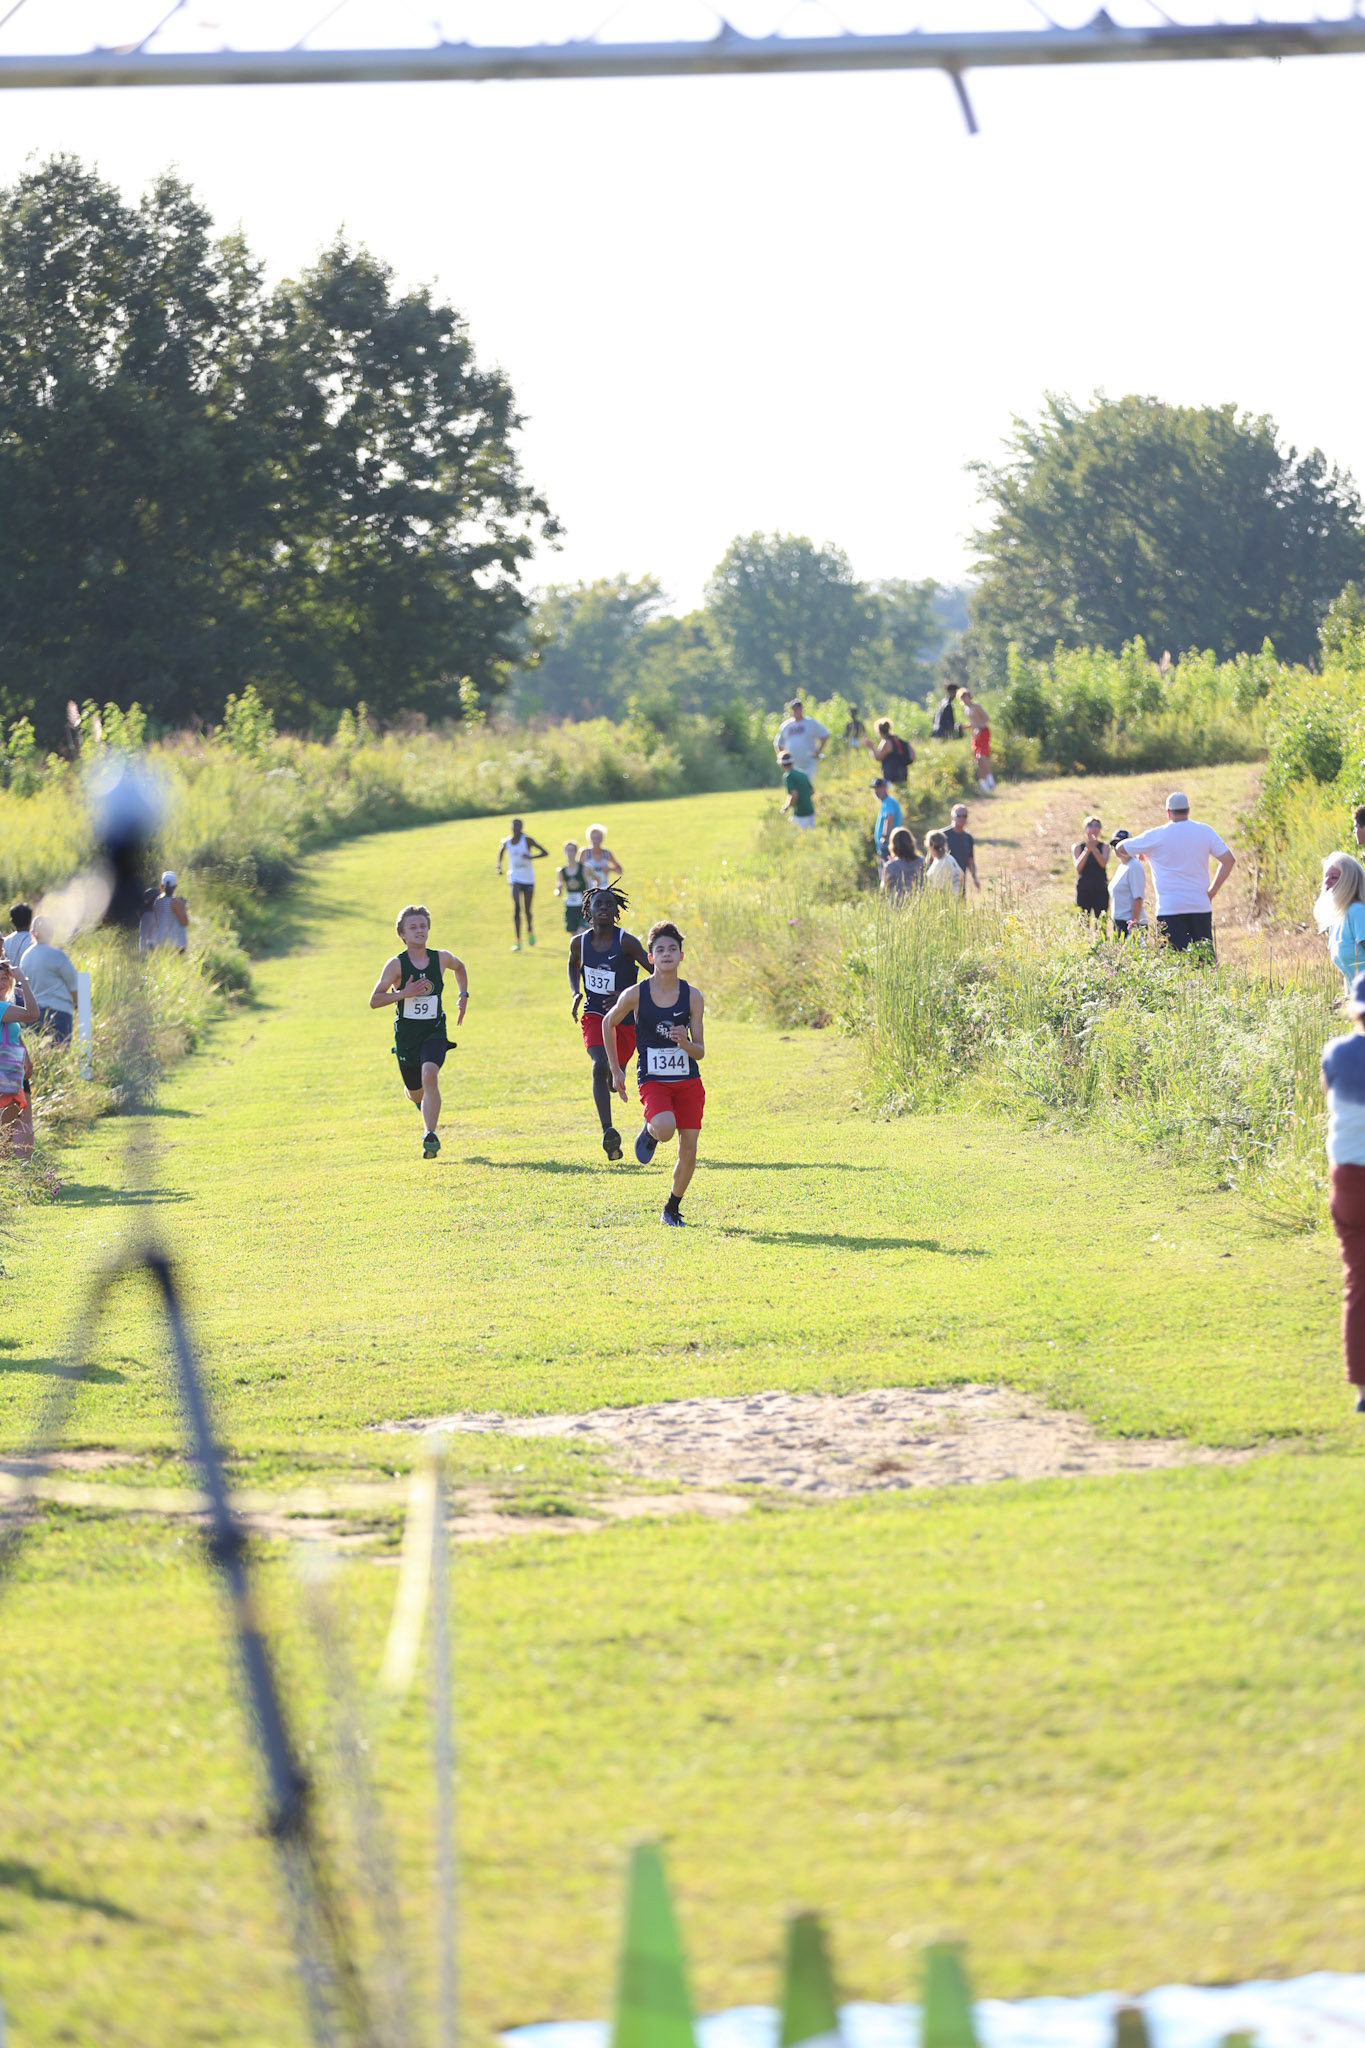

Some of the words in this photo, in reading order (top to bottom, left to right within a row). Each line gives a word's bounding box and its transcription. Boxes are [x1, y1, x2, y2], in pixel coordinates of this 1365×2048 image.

[587, 974, 611, 990] 1337
[413, 1003, 429, 1015] 59
[652, 1055, 686, 1070] 1344
